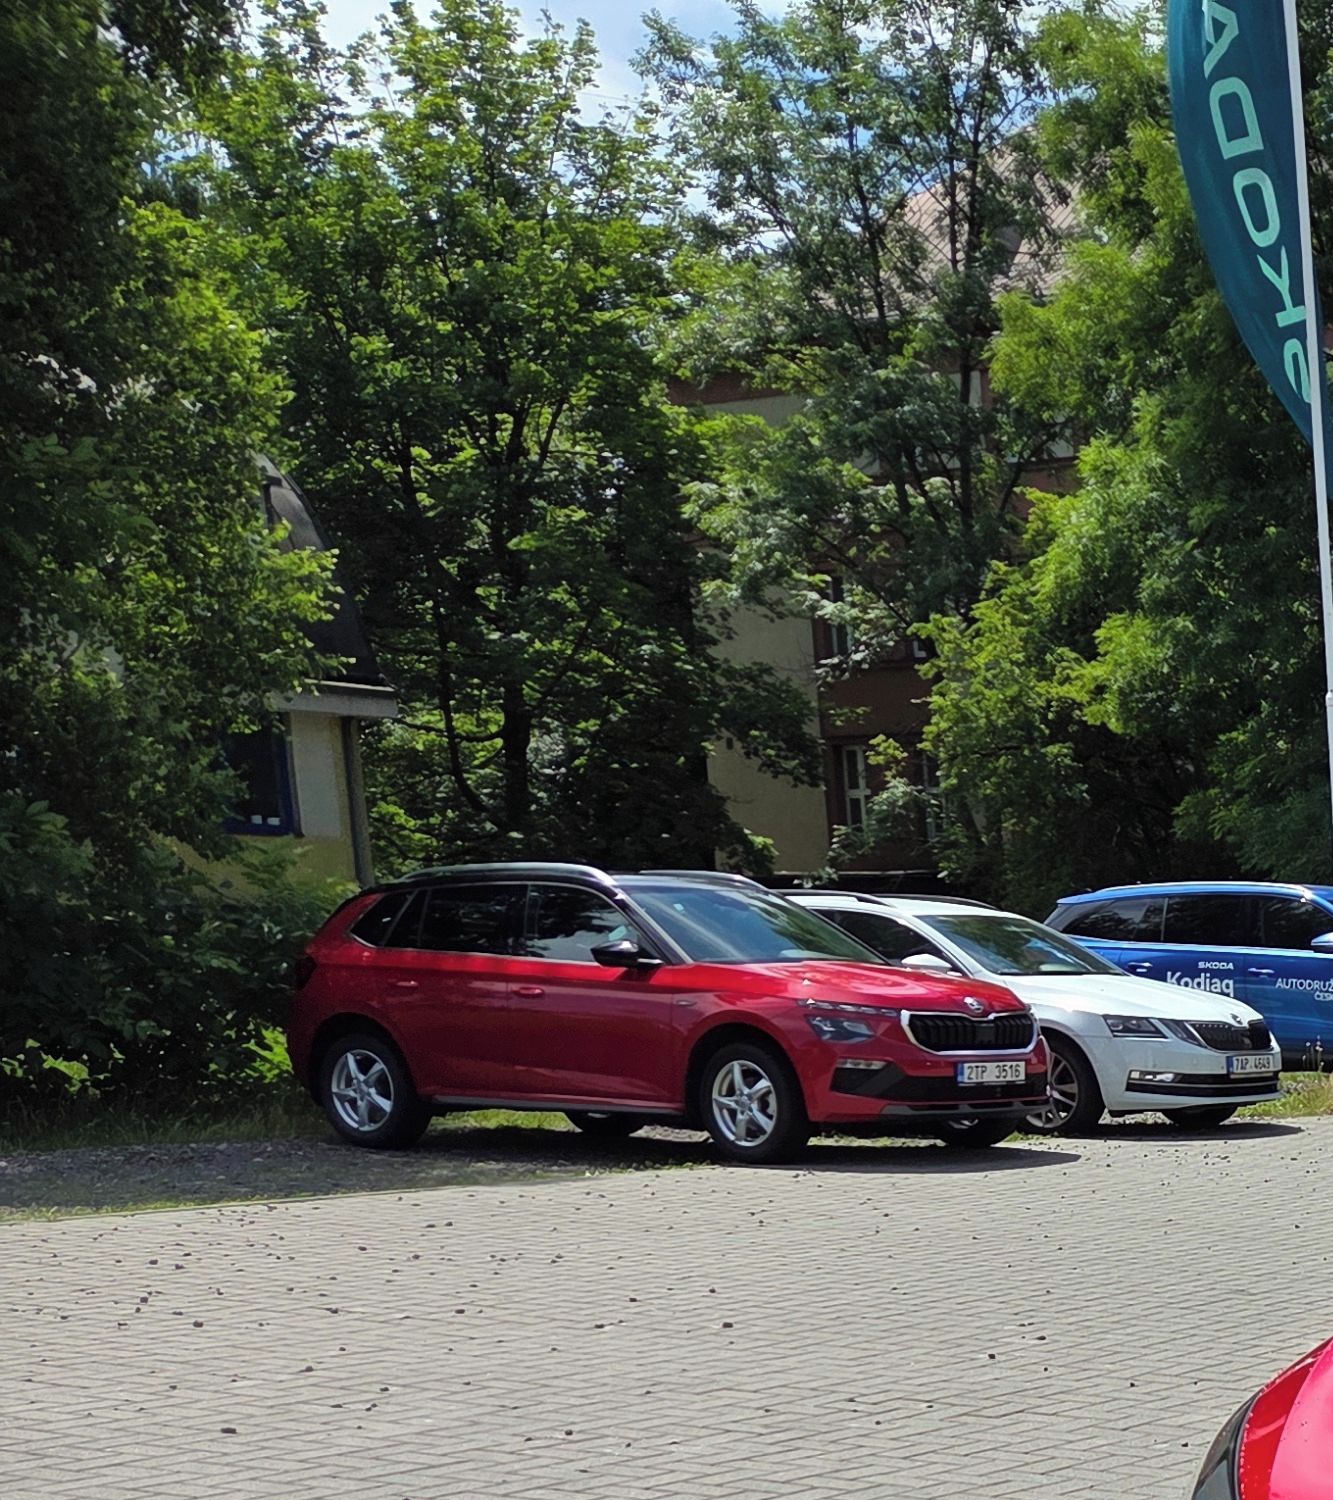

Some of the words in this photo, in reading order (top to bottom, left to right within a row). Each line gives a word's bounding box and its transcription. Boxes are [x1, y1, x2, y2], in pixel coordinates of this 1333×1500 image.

[1166, 971, 1234, 998] Kodiaq
[966, 1065, 988, 1080] 2TP
[995, 1064, 1021, 1079] 3516
